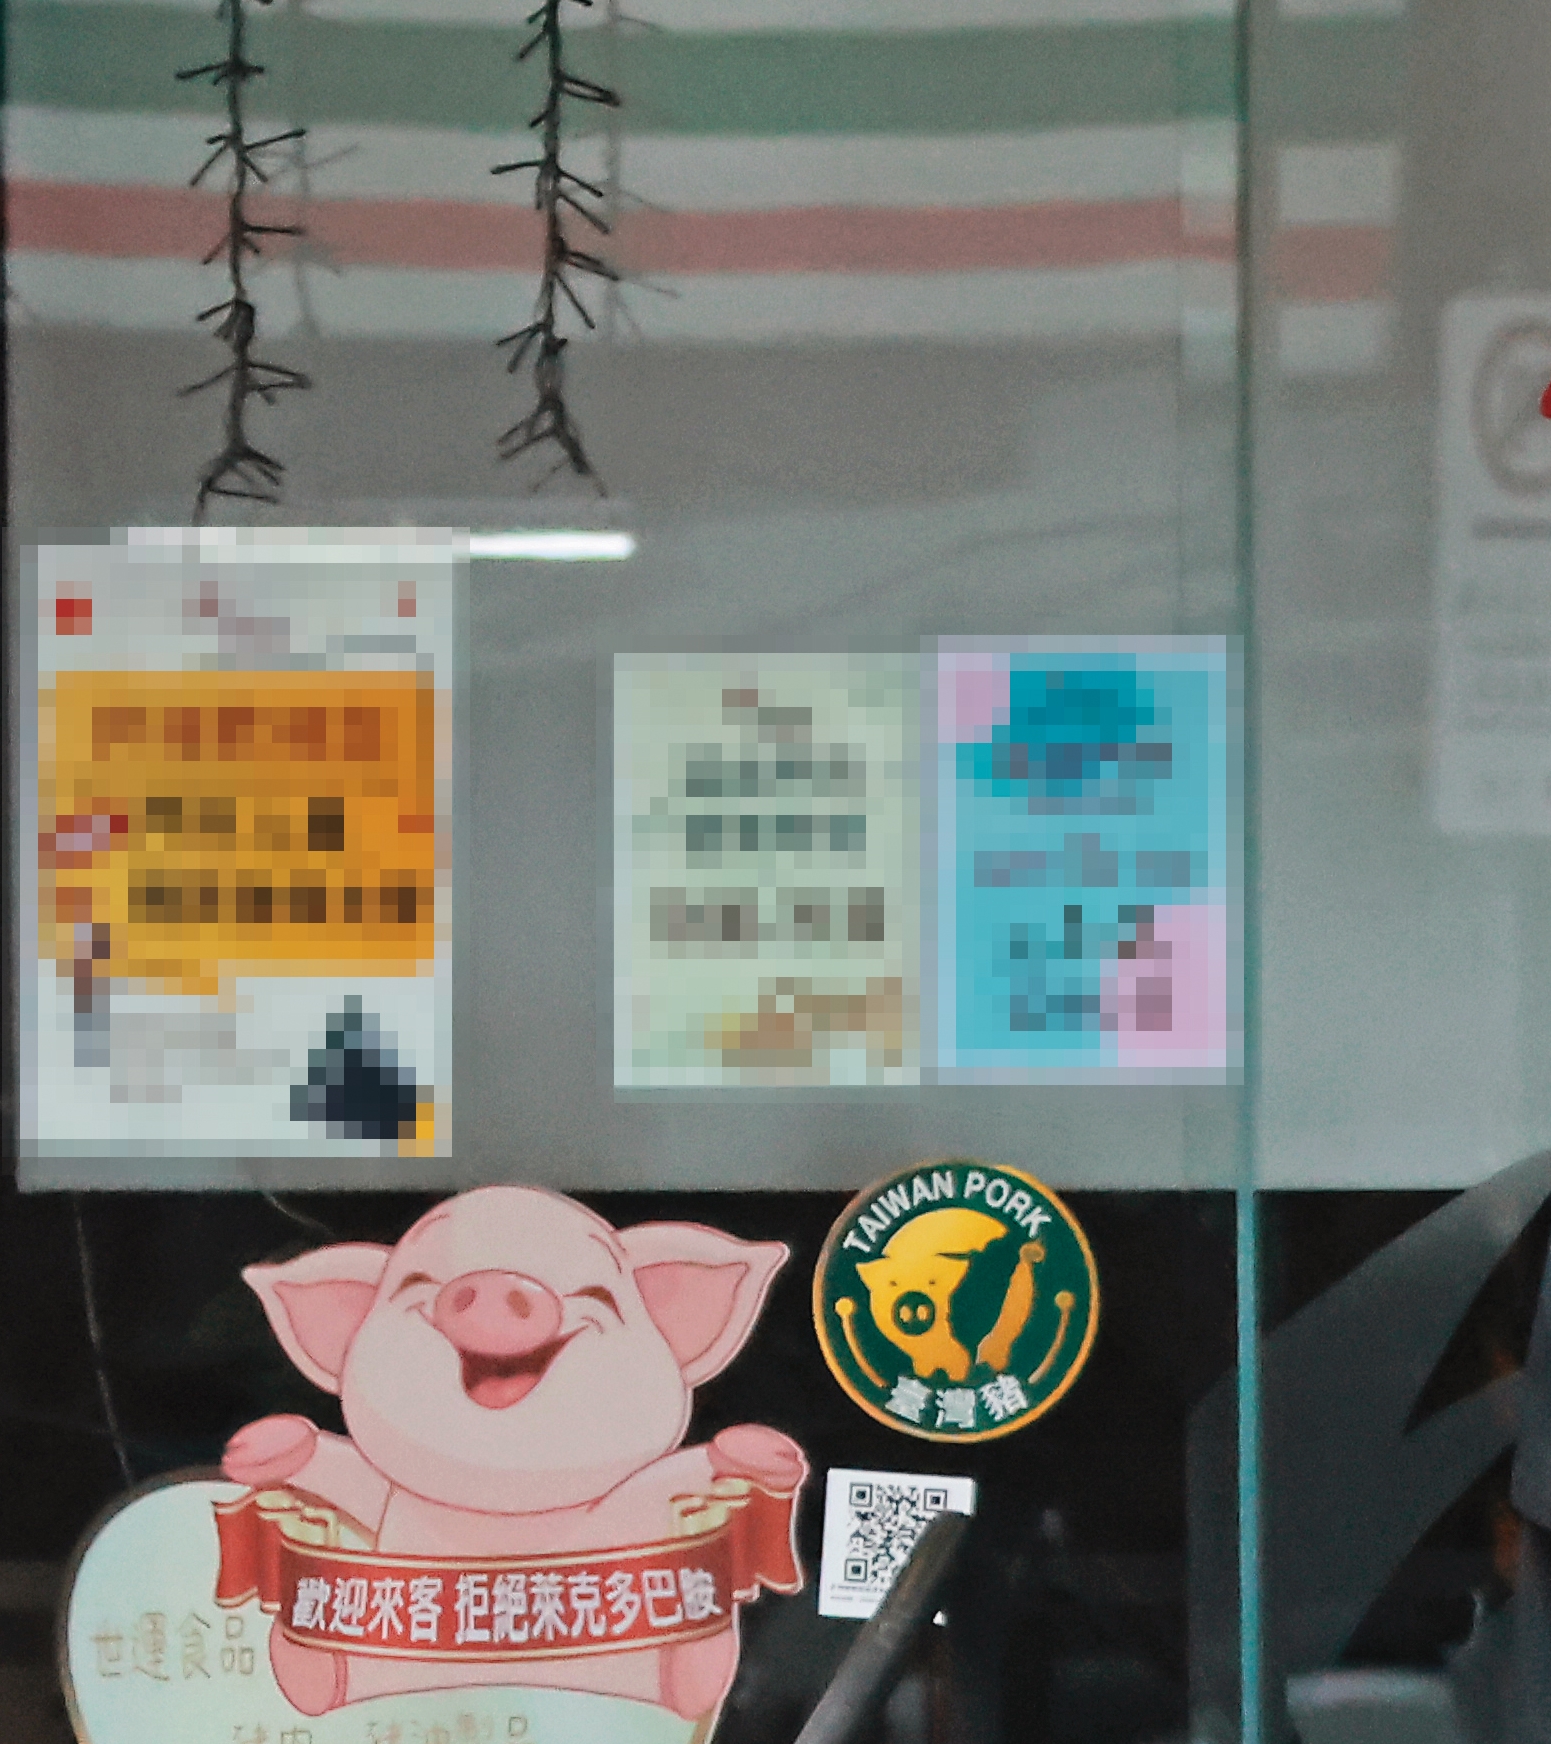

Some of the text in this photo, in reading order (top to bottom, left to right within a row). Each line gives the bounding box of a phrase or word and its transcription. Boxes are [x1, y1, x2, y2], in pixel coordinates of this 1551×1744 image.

[843, 1170, 1052, 1254] TAIWAN PORK
[292, 1575, 443, 1642] 歡迎來客
[88, 1612, 256, 1682] 世運食品
